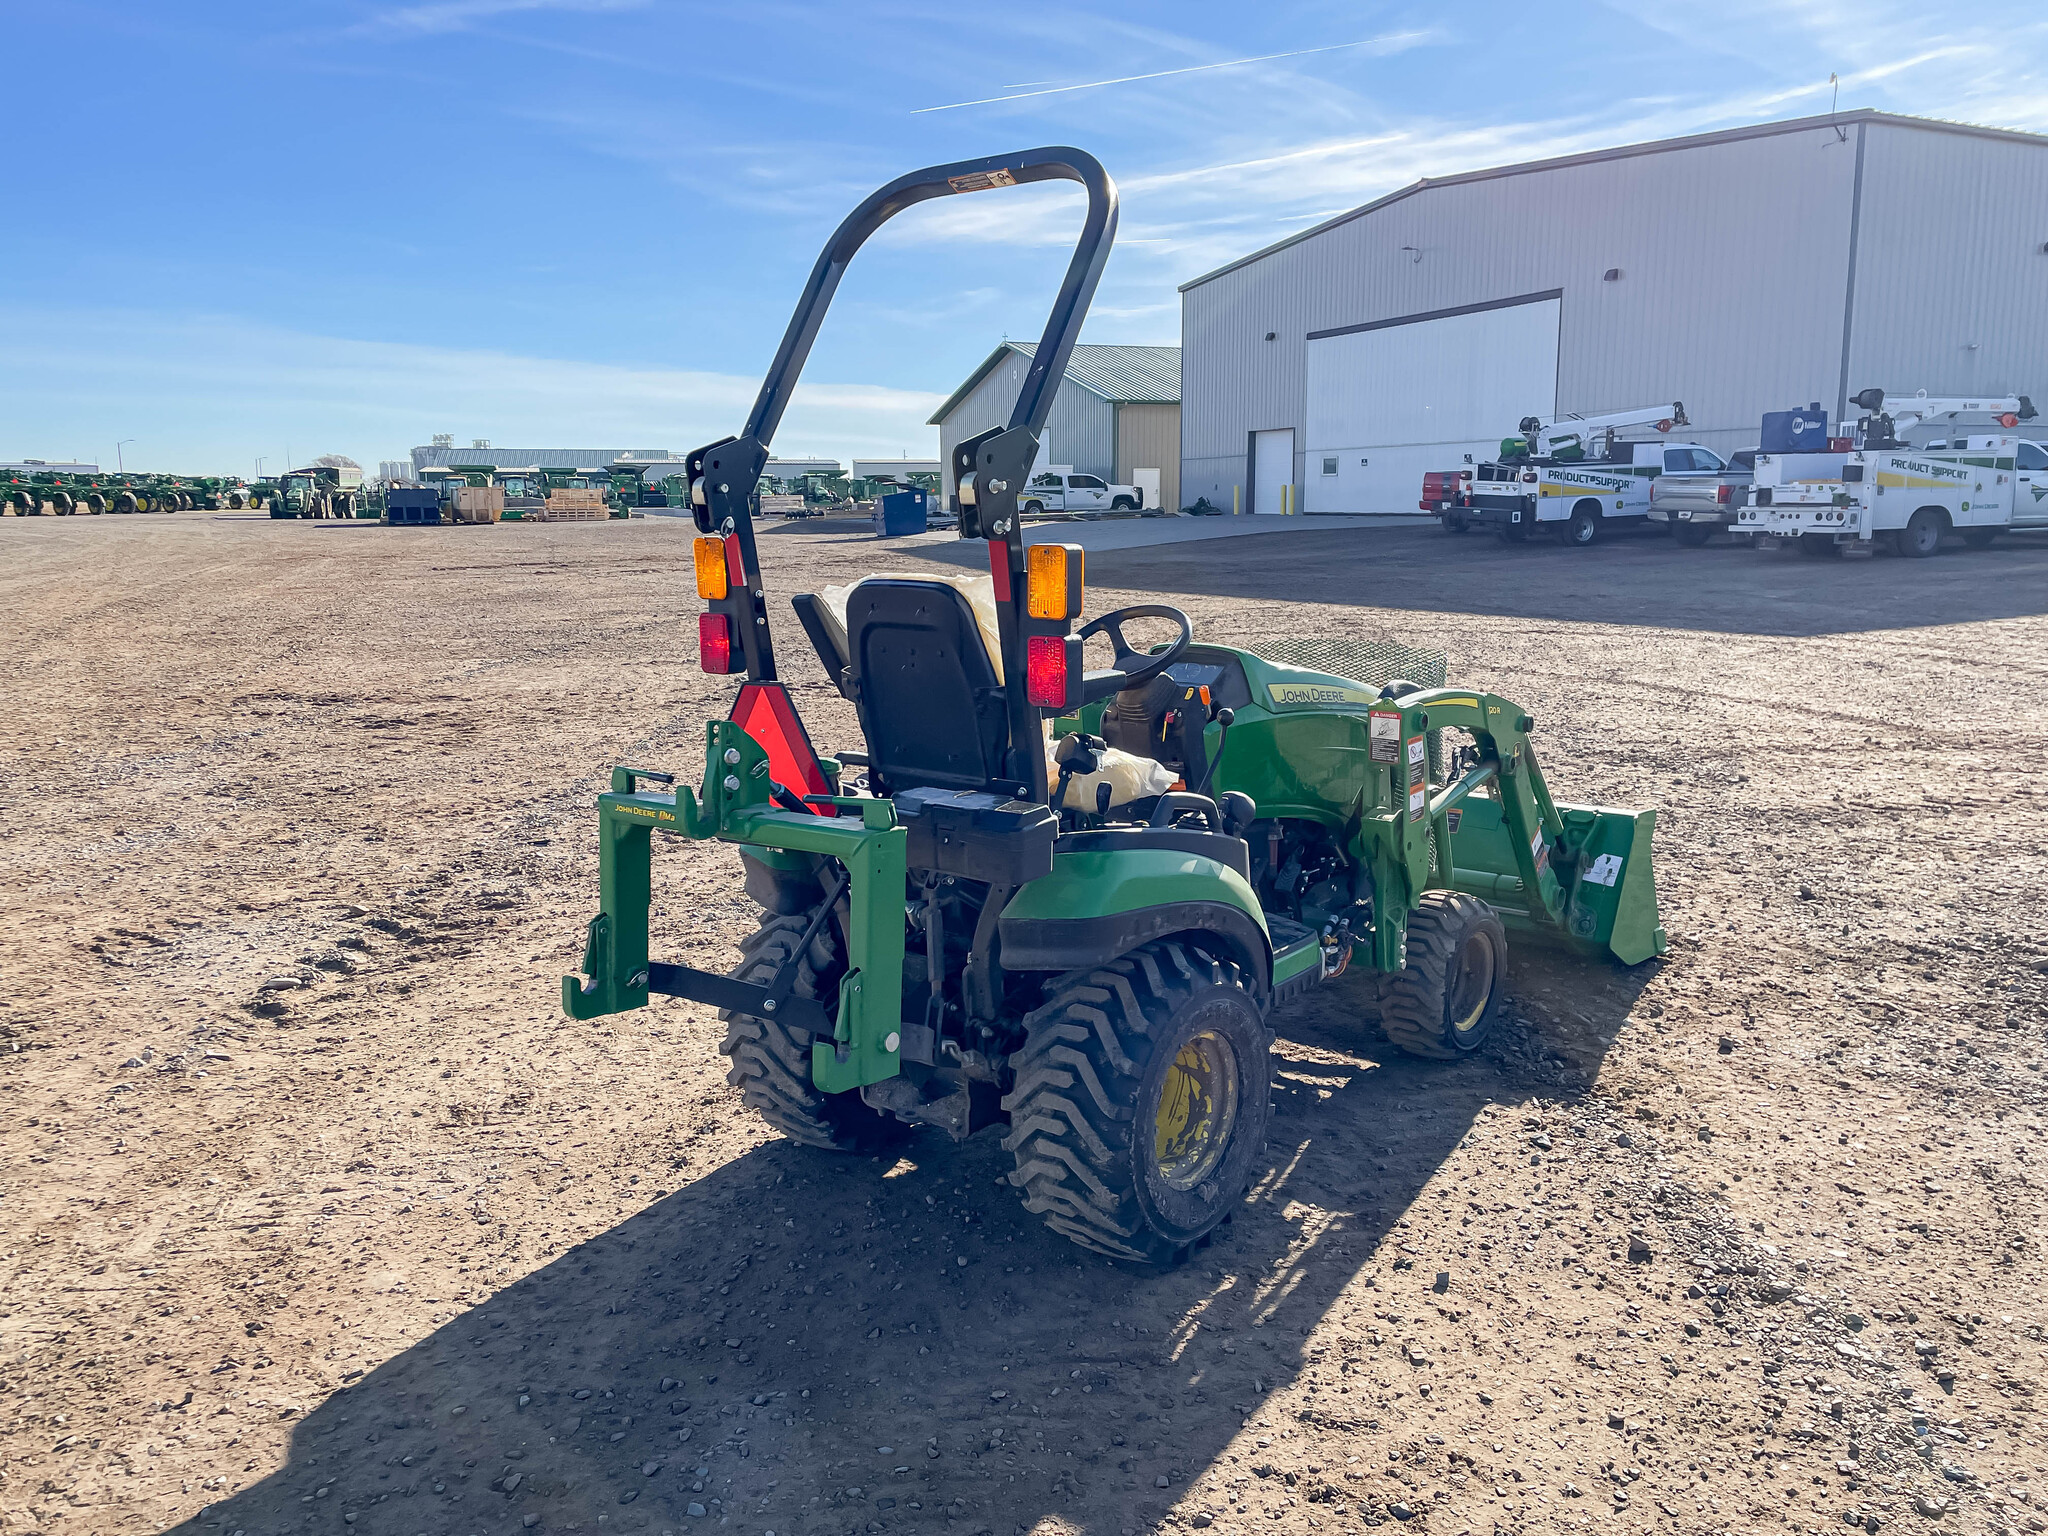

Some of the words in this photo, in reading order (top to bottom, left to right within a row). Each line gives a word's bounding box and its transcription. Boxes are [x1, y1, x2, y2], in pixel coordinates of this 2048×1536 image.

[1548, 470, 1590, 484] PRODUCT
[1281, 688, 1310, 701] JOHN
[1311, 688, 1345, 701] DEERE
[615, 804, 633, 814] JOHN
[633, 807, 656, 818] DEERE
